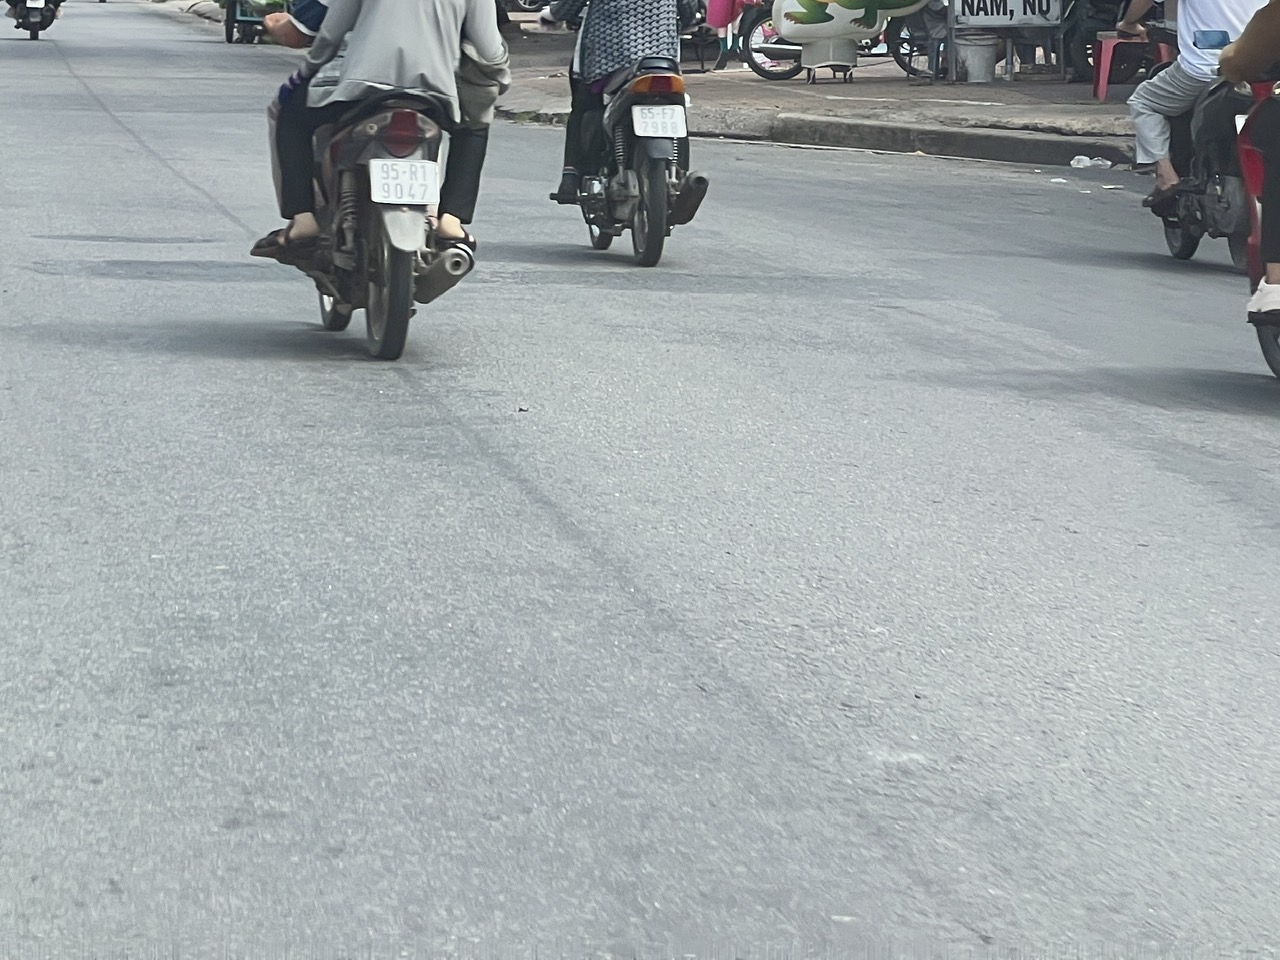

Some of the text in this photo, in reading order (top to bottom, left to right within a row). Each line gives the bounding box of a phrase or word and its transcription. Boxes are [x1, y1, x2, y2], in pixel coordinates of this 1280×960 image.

[640, 108, 675, 120] 65-F7
[381, 162, 427, 181] 95-R1
[381, 185, 428, 200] 9047
